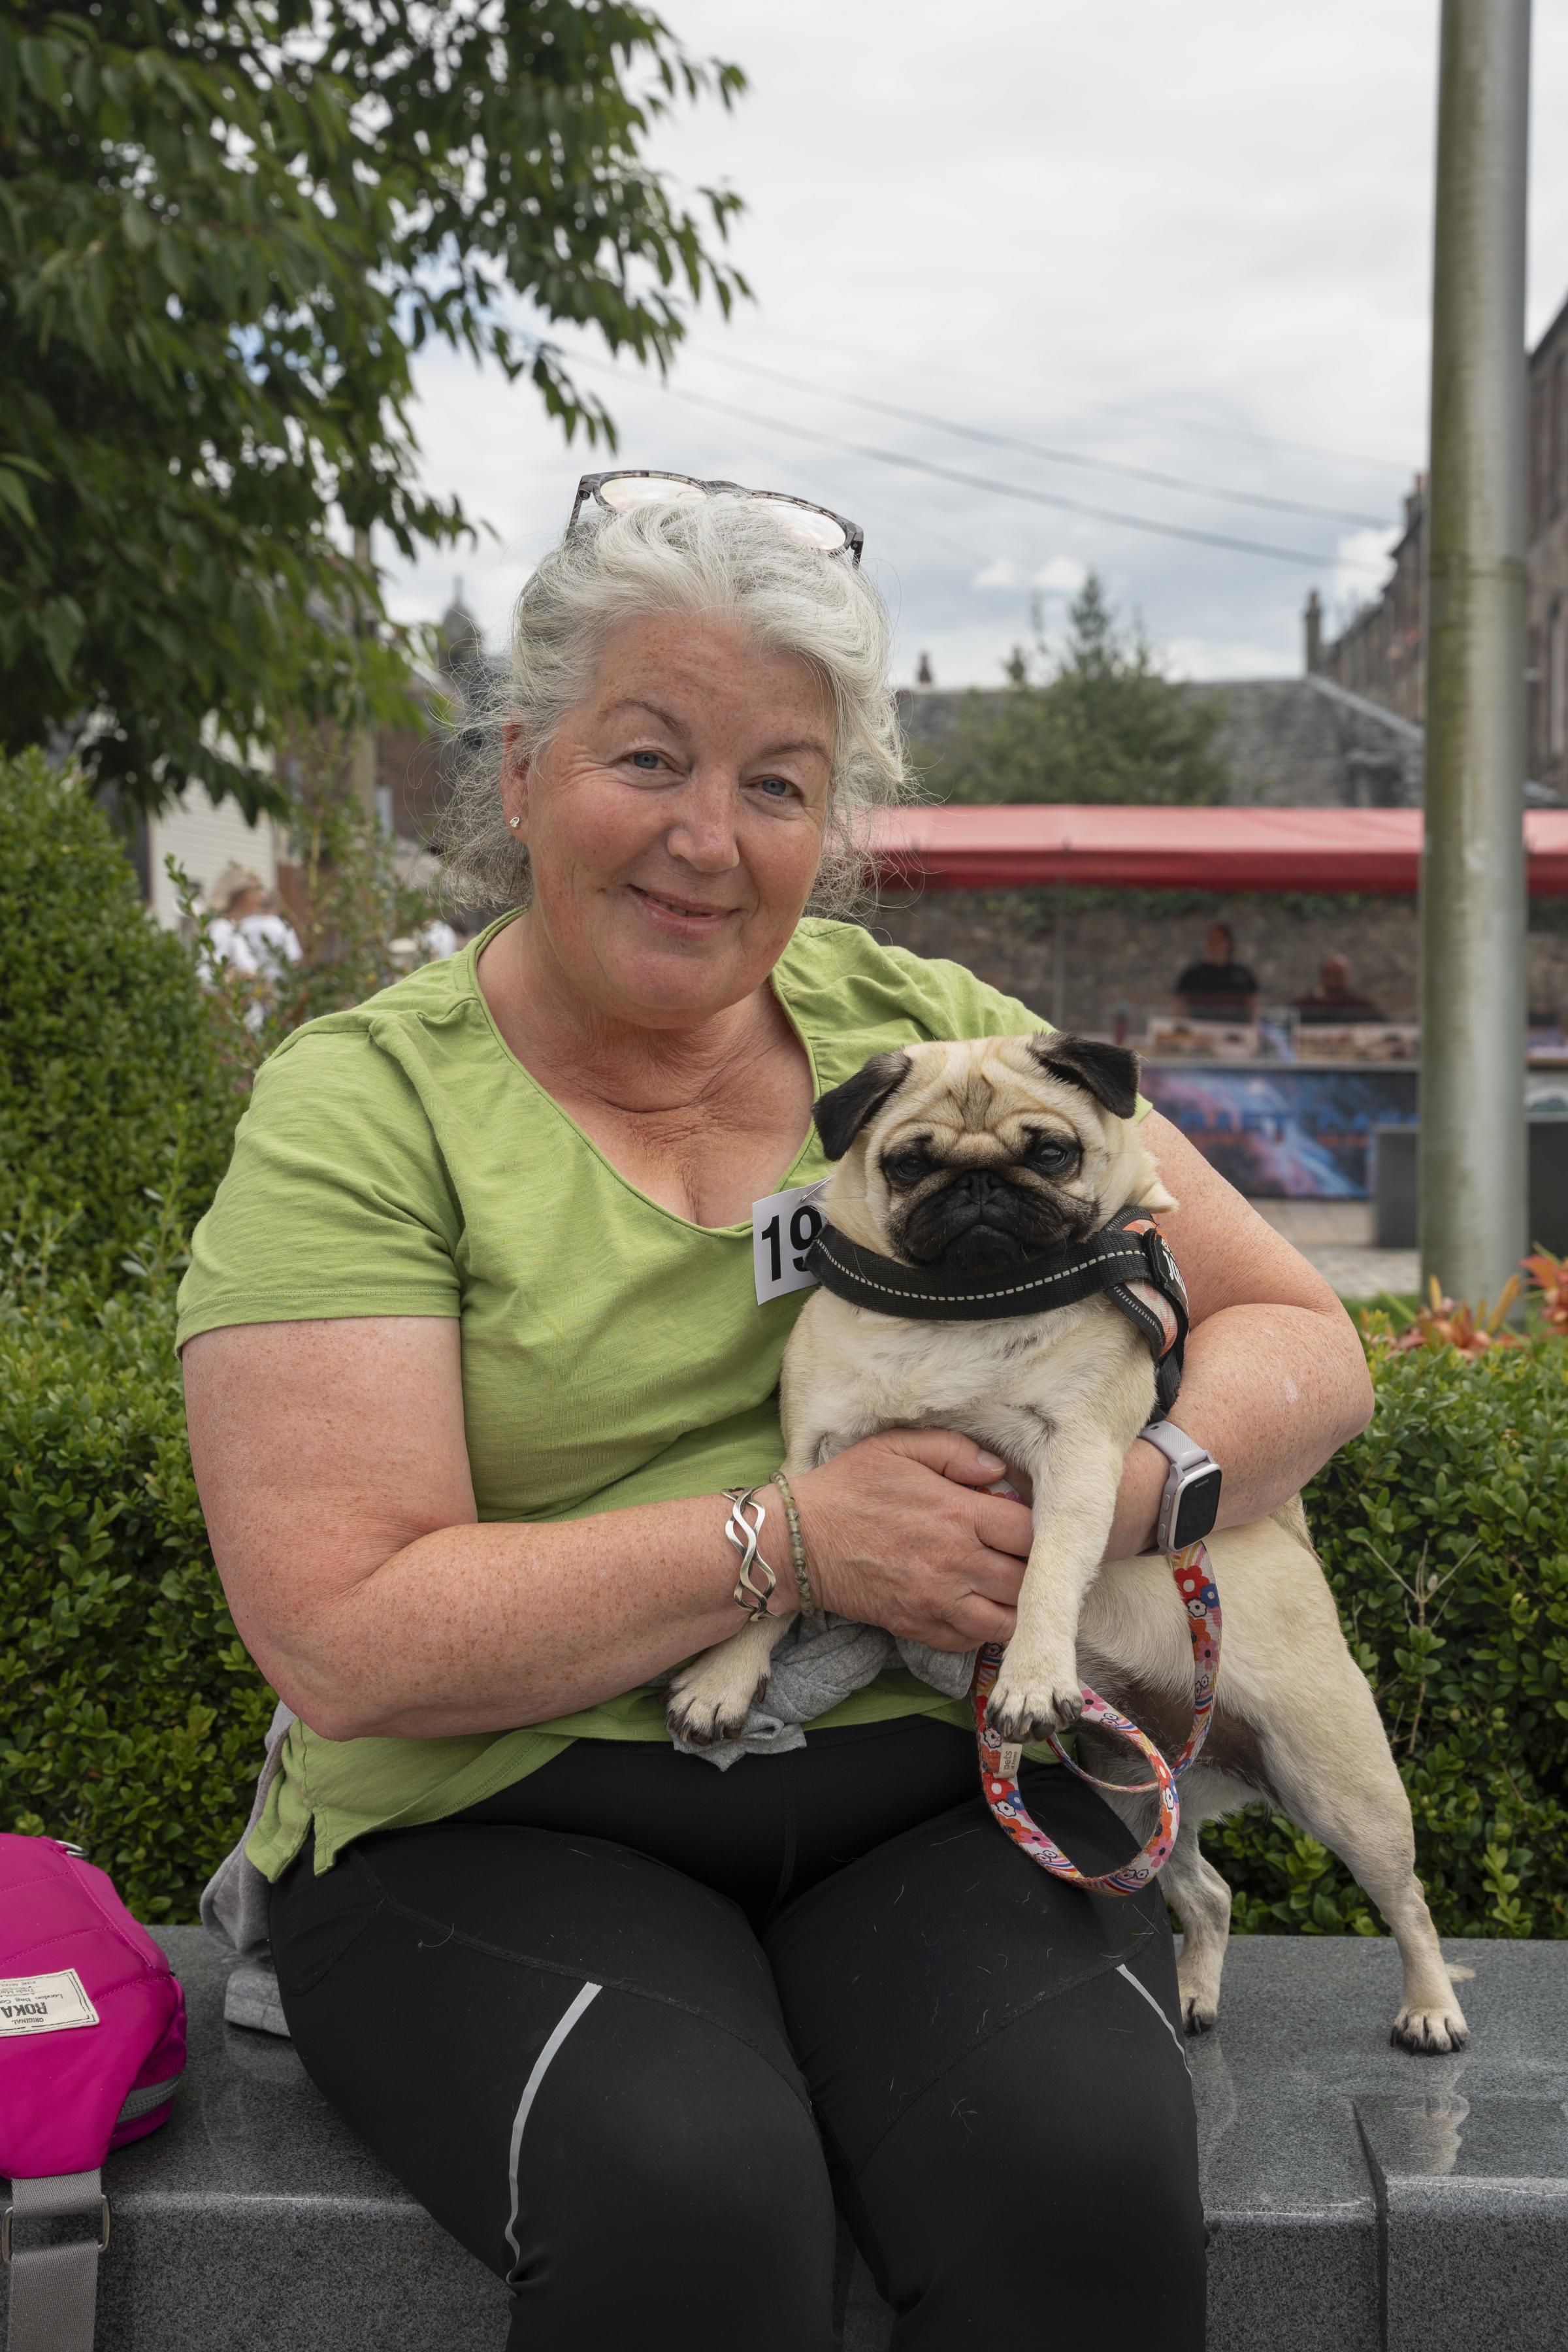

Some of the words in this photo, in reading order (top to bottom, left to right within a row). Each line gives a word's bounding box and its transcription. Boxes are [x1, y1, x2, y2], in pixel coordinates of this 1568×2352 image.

[761, 1205, 823, 1282] 19
[1004, 1751, 1012, 1770] pets
[0, 2002, 48, 2018] ROKA
